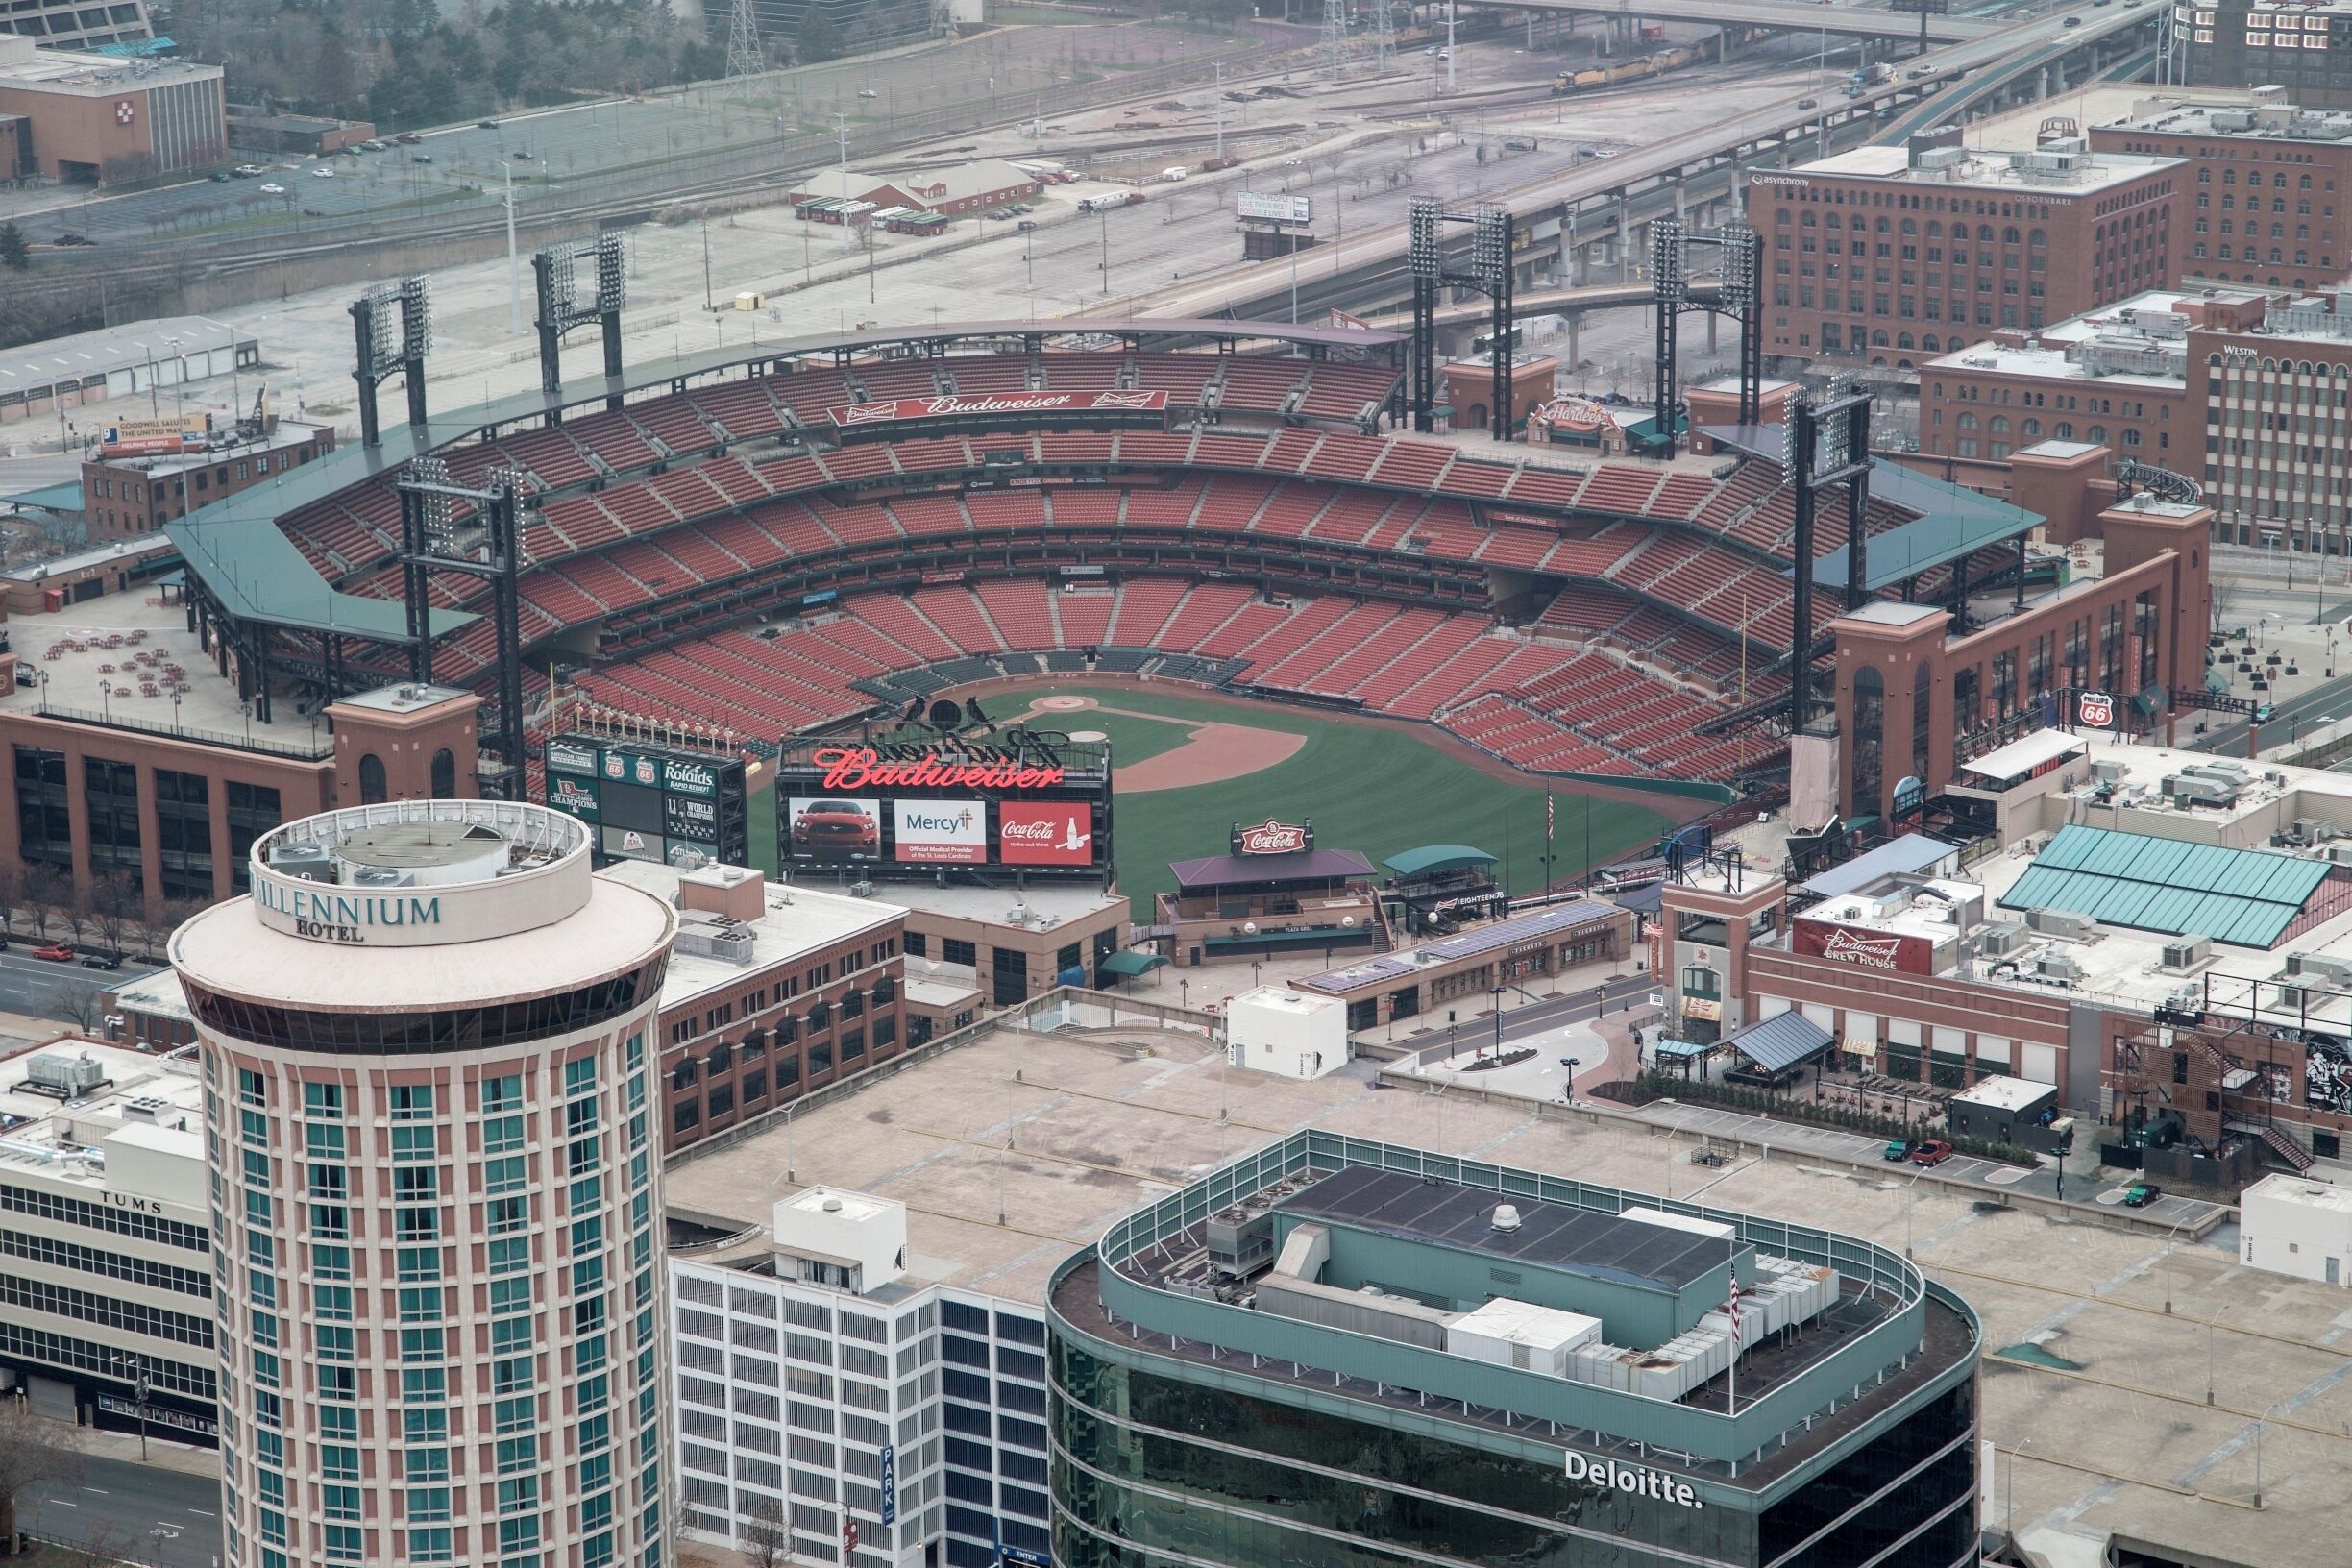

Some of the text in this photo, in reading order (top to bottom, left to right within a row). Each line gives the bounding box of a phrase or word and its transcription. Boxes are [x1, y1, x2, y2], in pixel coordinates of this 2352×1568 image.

[1763, 176, 1810, 187] asynchrony
[919, 393, 1070, 413] Budweiser
[120, 421, 159, 429] GOODWILL
[136, 429, 164, 437] UNITED
[165, 426, 181, 434] WAY
[2084, 696, 2109, 705] PHILLIPS
[2084, 706, 2107, 723] 66
[608, 765, 621, 774] 66
[639, 770, 651, 779] 66
[813, 748, 1064, 790] Budweiser
[670, 780, 688, 789] RAPID
[550, 796, 598, 810] CHAMPIONS
[668, 798, 713, 815] 11 WORLD
[687, 811, 714, 821] CHAMPIONS
[907, 814, 959, 834] Mercy
[1002, 821, 1056, 839] Coca-Cola
[250, 870, 441, 926] MILLENNIUM
[295, 919, 364, 943] HOTEL
[1825, 934, 1898, 956] Budweiser
[1825, 949, 1898, 970] BREW HOUSE
[100, 1190, 161, 1214] TUMS
[884, 1448, 893, 1507] PARK
[1016, 1550, 1037, 1562] ENTER
